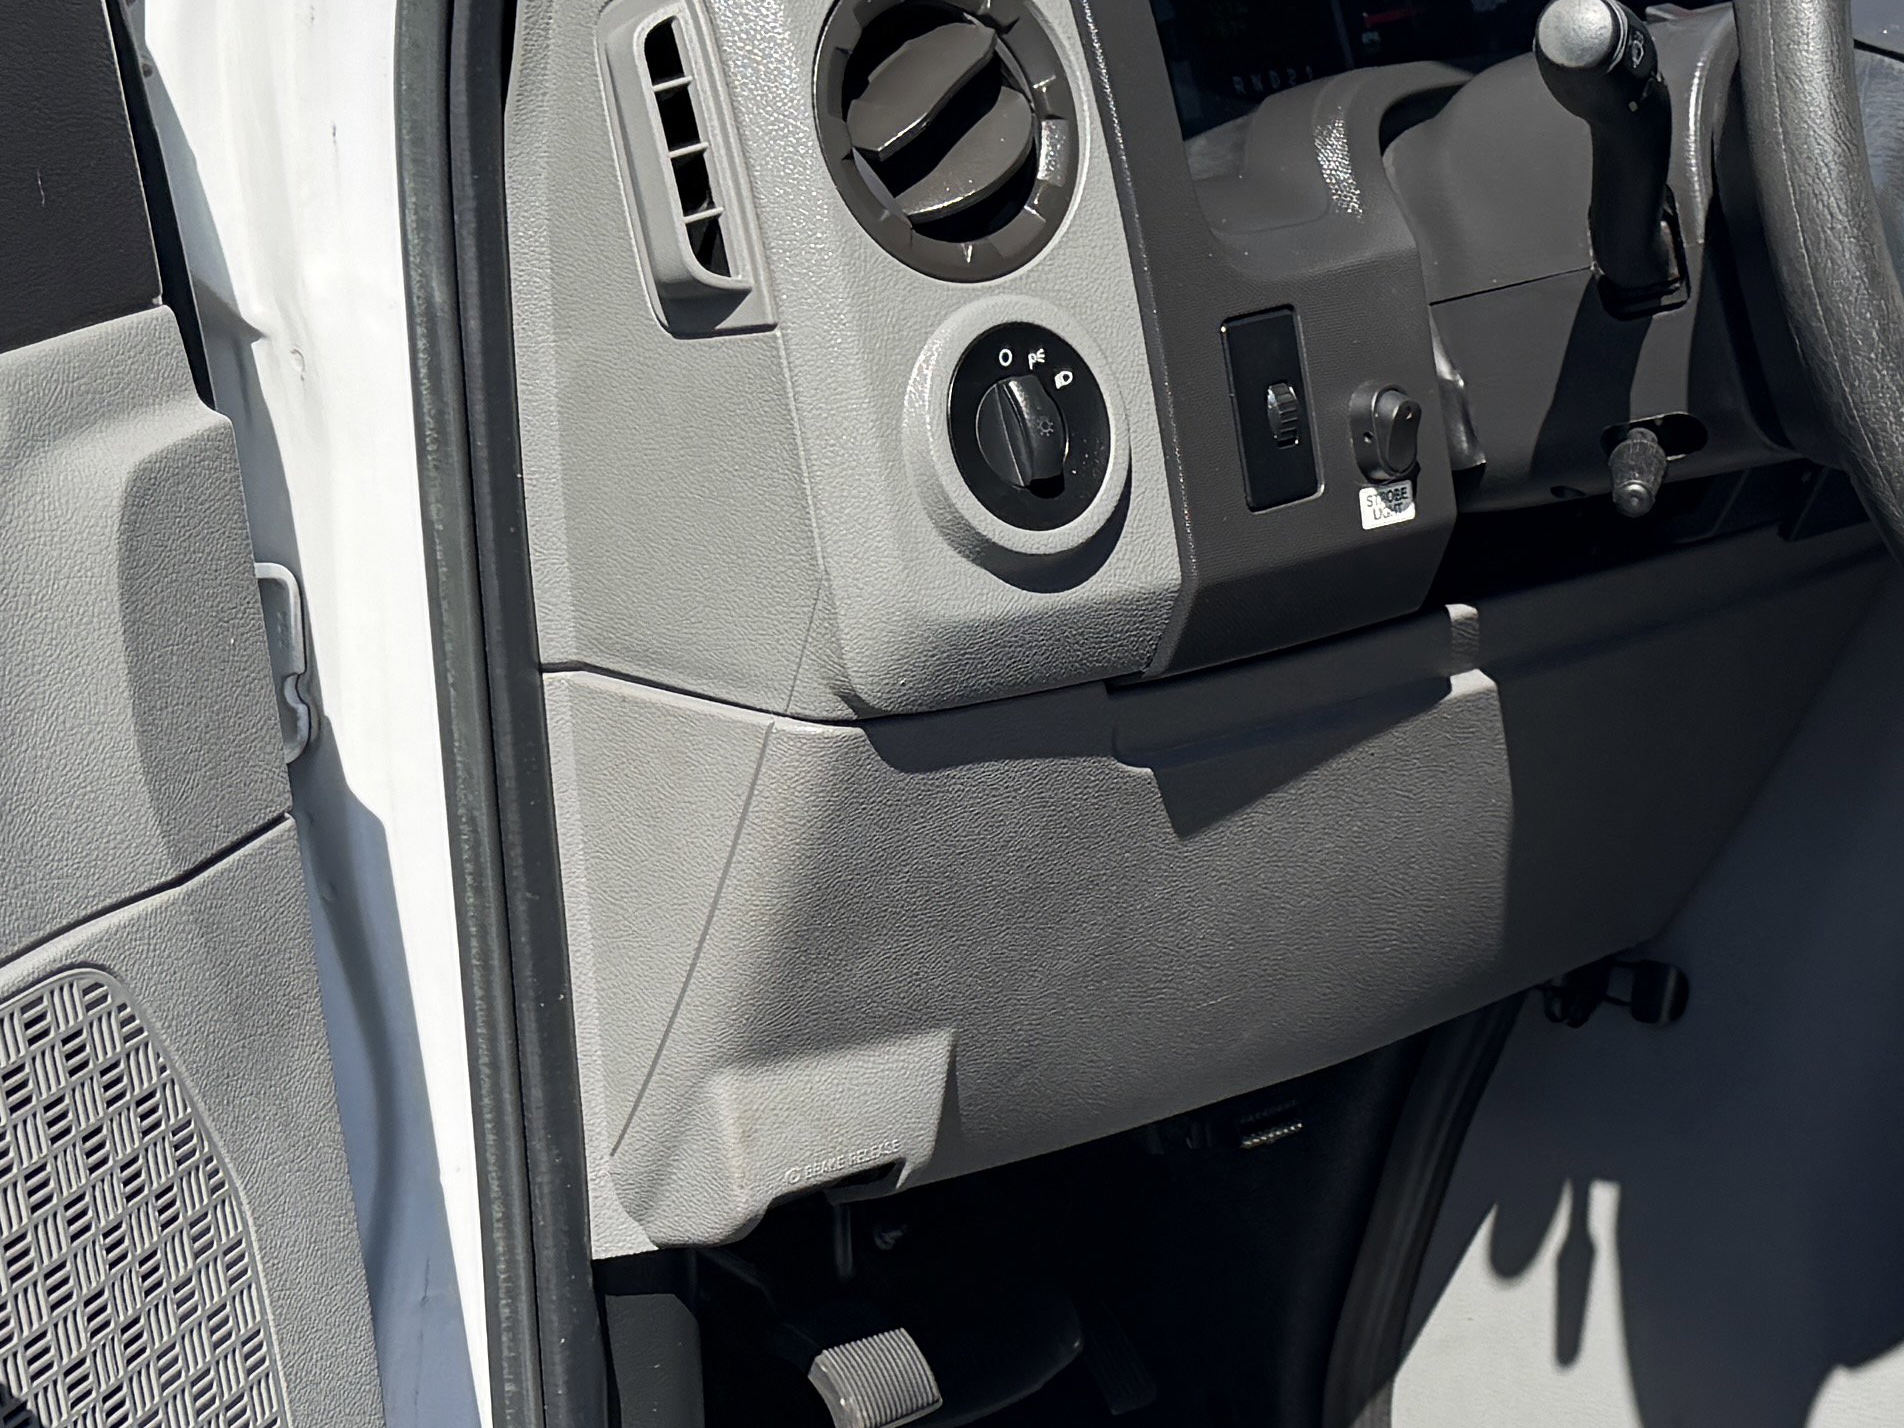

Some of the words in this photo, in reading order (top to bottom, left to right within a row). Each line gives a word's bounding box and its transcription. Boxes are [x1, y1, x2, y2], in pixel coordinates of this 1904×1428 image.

[1366, 487, 1409, 508] STROBE
[805, 1155, 846, 1180] BRAKE
[848, 1139, 901, 1168] RELEASE
